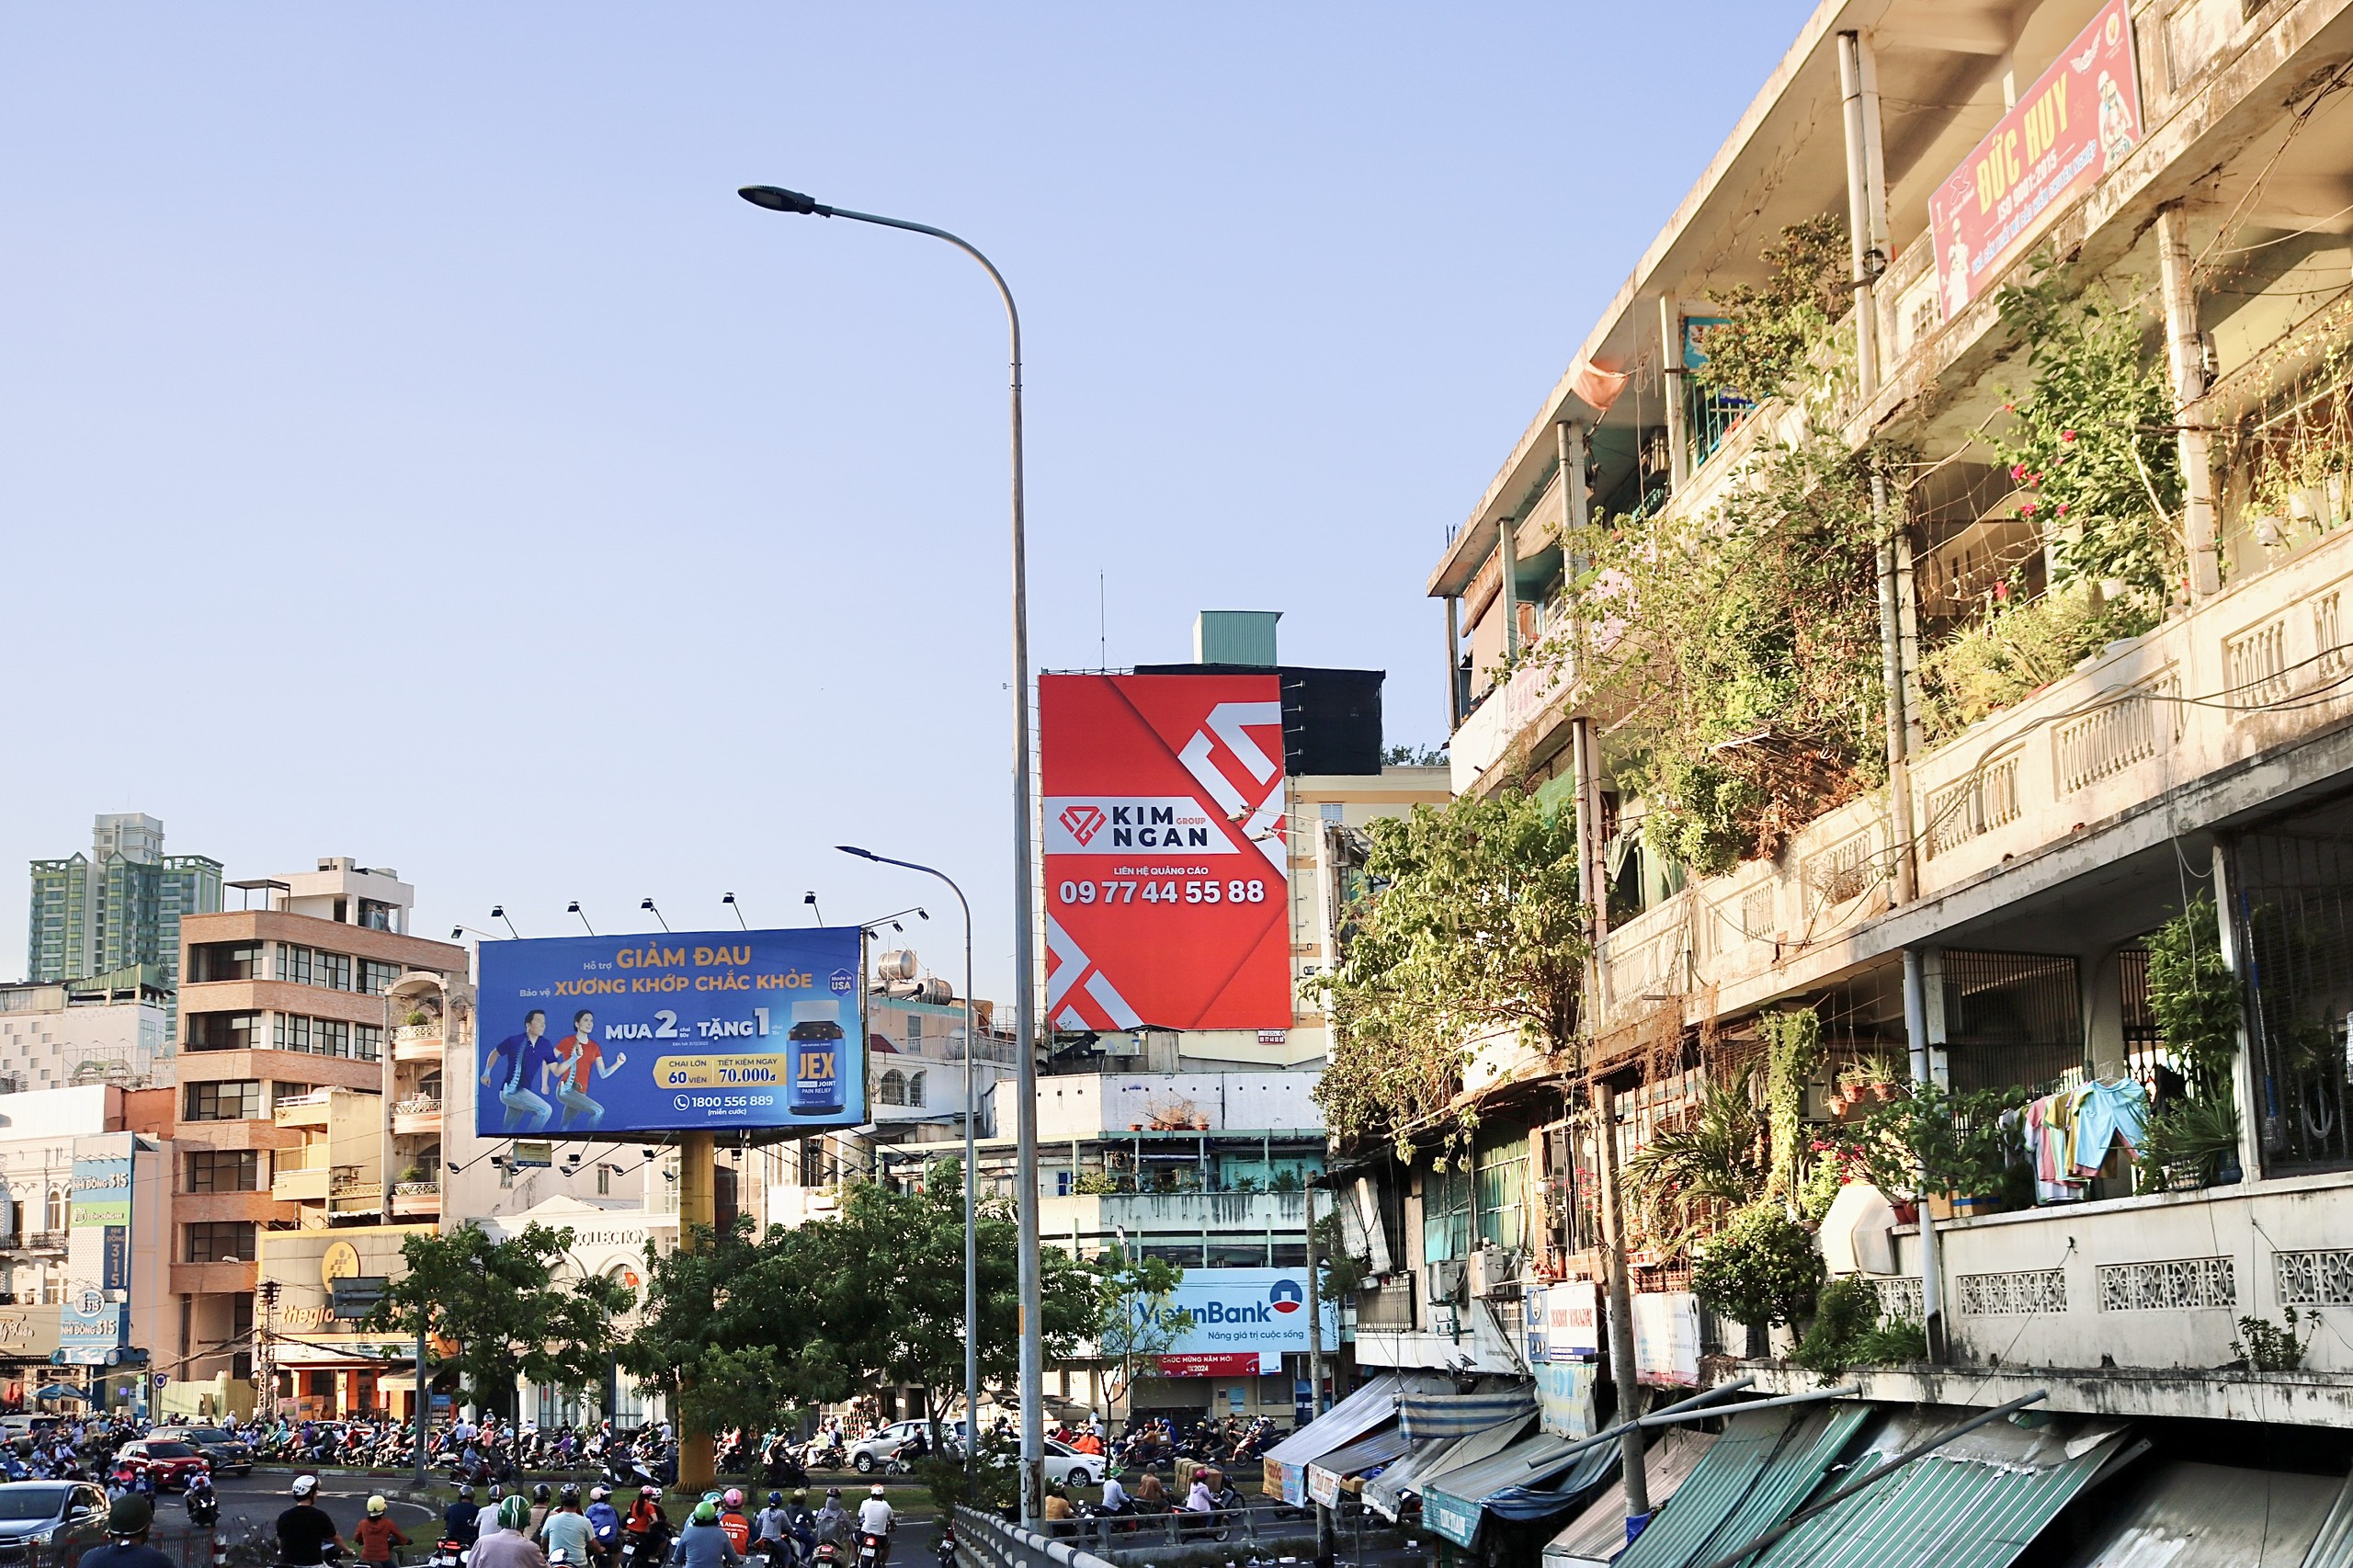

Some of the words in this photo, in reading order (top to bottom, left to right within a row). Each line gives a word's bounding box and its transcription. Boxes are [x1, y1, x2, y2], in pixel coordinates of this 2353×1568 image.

[1976, 129, 2020, 216] ĐỨC
[2024, 70, 2067, 167] HUY
[1997, 194, 2012, 223] ISO
[2013, 148, 2057, 208] 9001:2015
[1113, 806, 1173, 825] KIM
[1176, 817, 1206, 825] GROUP
[1113, 827, 1208, 847] NGAN
[1113, 866, 1134, 875] LIÊN
[1136, 866, 1149, 877] HỆ
[1151, 865, 1185, 875] QUẢNG
[1187, 866, 1209, 875] CÁO
[1059, 881, 1097, 904] 09
[1101, 881, 1138, 903] 77
[1142, 881, 1178, 903] 44
[1185, 881, 1221, 903] 55
[1227, 880, 1265, 903] 88
[583, 960, 597, 971] Hỗ
[598, 961, 612, 971] trợ
[616, 941, 686, 969] GIẢM
[692, 946, 751, 966] ĐAU
[519, 988, 537, 997] Bảo
[540, 988, 551, 997] vệ
[554, 977, 626, 996] XƯƠNG
[631, 973, 689, 993] KHỚP
[695, 970, 751, 992] CHẮC
[756, 968, 813, 990] KHỎE
[831, 981, 851, 991] USA
[605, 1024, 653, 1040] MUA
[654, 1009, 677, 1039] 2
[697, 1017, 754, 1040] TẶNG
[753, 1007, 769, 1036] 1
[690, 1059, 707, 1067] LỚN
[717, 1058, 733, 1066] TIẾT
[734, 1058, 755, 1066] KIỆM
[796, 1051, 835, 1080] JEX
[668, 1071, 688, 1085] 60
[691, 1096, 722, 1108] 1800
[723, 1096, 747, 1107] 556
[749, 1095, 774, 1107] 889
[73, 1180, 85, 1190] NHI
[108, 1173, 130, 1188] 315
[574, 1229, 644, 1246] COLLECTION
[61, 1325, 74, 1335] NHI
[96, 1320, 117, 1335] 315
[1208, 1331, 1232, 1341] Nâng
[1233, 1331, 1248, 1341] giá
[1249, 1331, 1258, 1341] trị
[1260, 1332, 1281, 1341] cuộc
[1283, 1330, 1304, 1340] sống
[1182, 1355, 1202, 1363] MỪNG
[1203, 1355, 1218, 1363] NĂM
